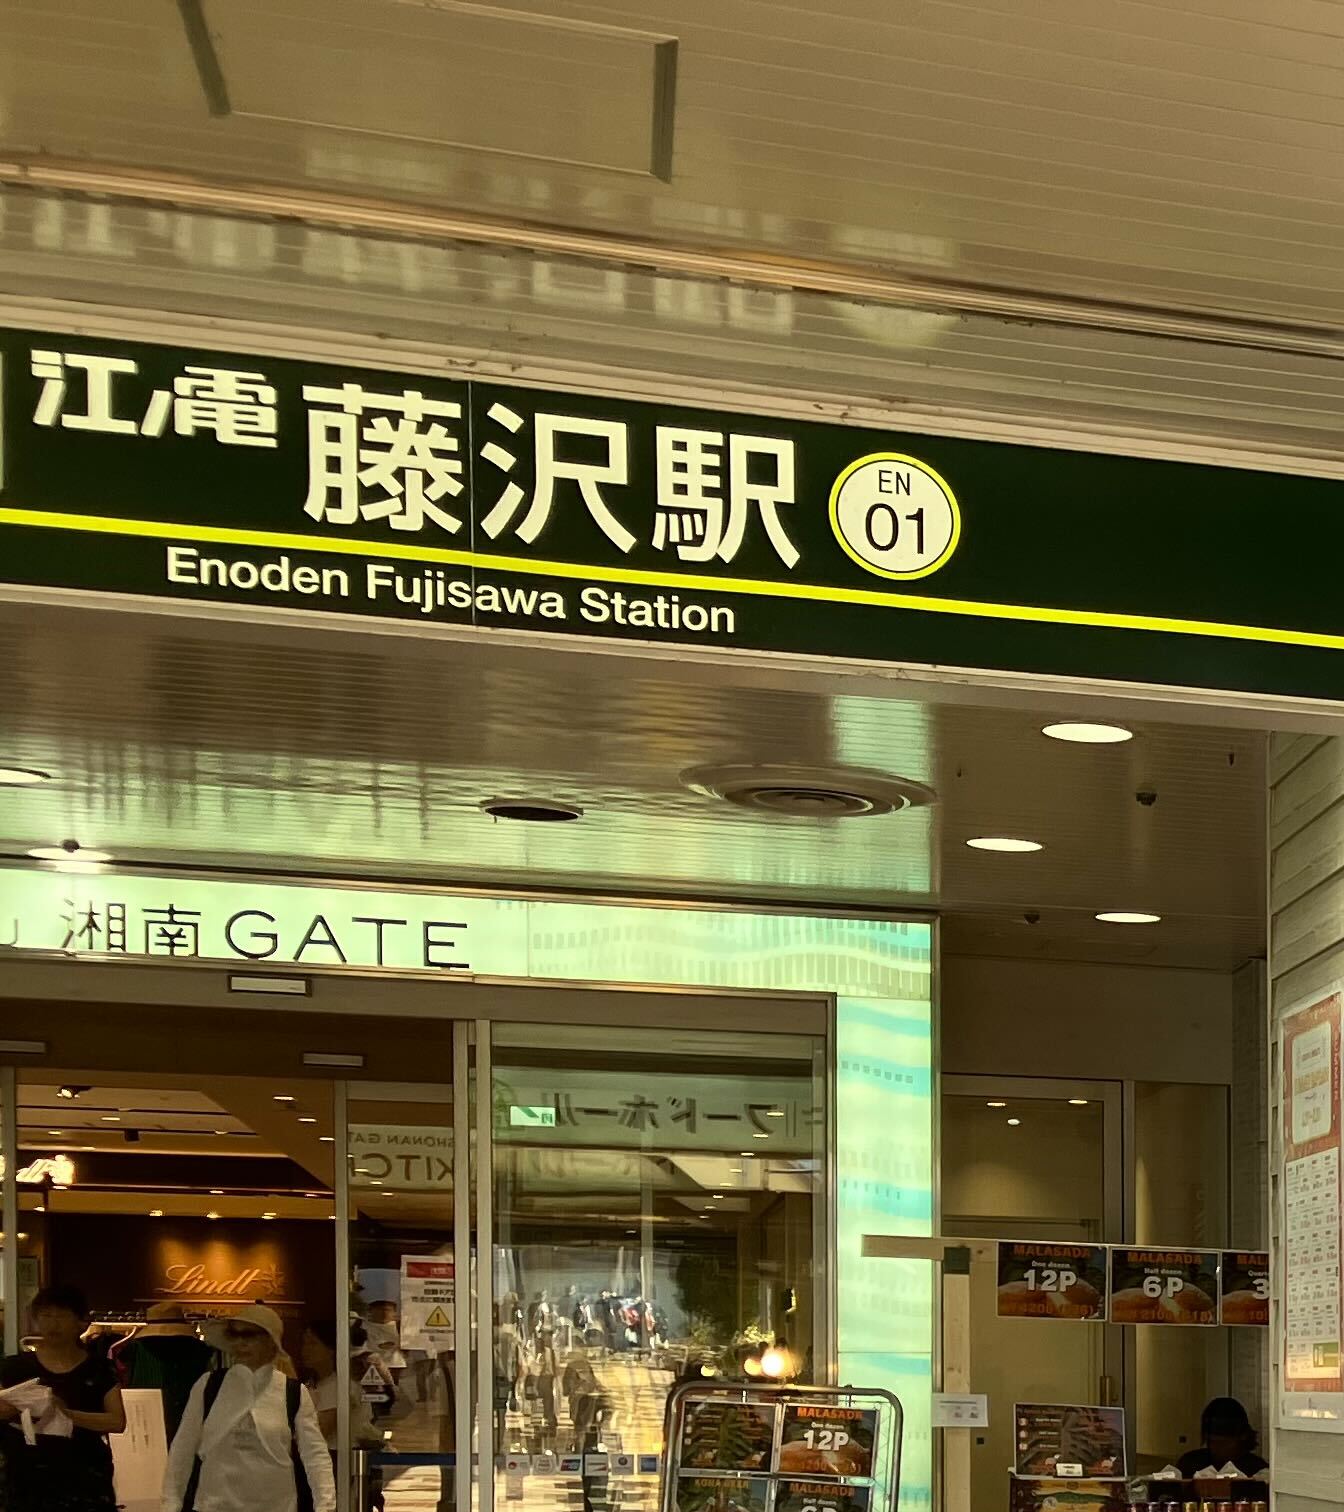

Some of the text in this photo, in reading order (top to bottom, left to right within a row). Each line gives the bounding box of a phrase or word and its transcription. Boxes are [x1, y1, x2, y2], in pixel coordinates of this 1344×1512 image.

[302, 383, 801, 570] 藤沢駅
[878, 469, 912, 497] EN
[865, 503, 927, 555] 01
[166, 545, 736, 634] Enoden Fujisawa Station
[60, 900, 202, 957] 湘南
[224, 909, 471, 971] GATE
[160, 1263, 260, 1297] Lindt
[1023, 1269, 1077, 1293] 12P
[1143, 1276, 1185, 1299] 6P
[803, 1431, 850, 1451] 12P
